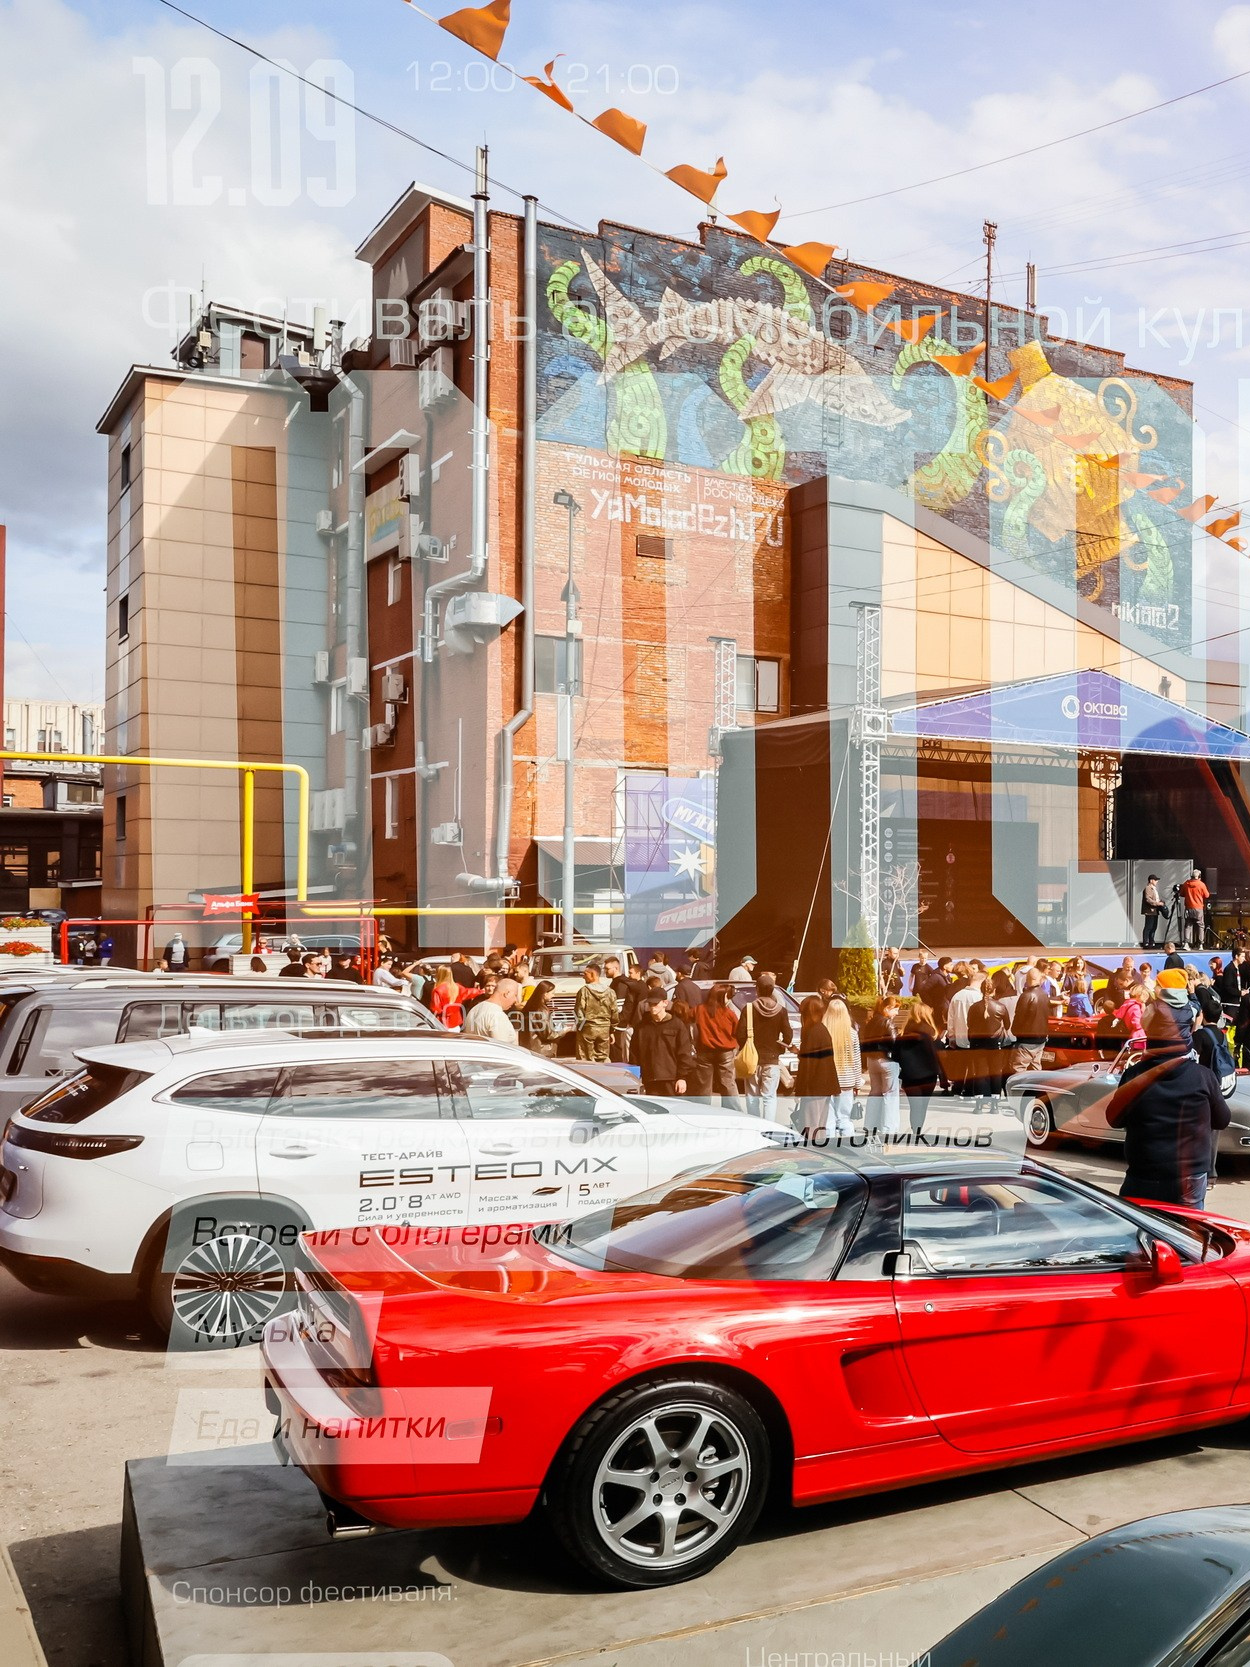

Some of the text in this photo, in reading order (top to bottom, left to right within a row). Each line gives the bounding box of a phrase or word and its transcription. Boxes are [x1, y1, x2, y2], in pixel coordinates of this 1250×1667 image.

[634, 464, 691, 484] ОБЛАСТЬ
[624, 476, 681, 493] МОЛОДЫХ
[361, 1150, 443, 1162] ТЕСТ-ДРАЙВ
[359, 1156, 618, 1188] ESTEO MX
[440, 1191, 462, 1200] AWD
[578, 1184, 590, 1196] 5
[479, 1194, 519, 1203] Массаж
[486, 1201, 558, 1213] ароматизация
[357, 1213, 384, 1222] Сила
[395, 1208, 464, 1221] уверенность
